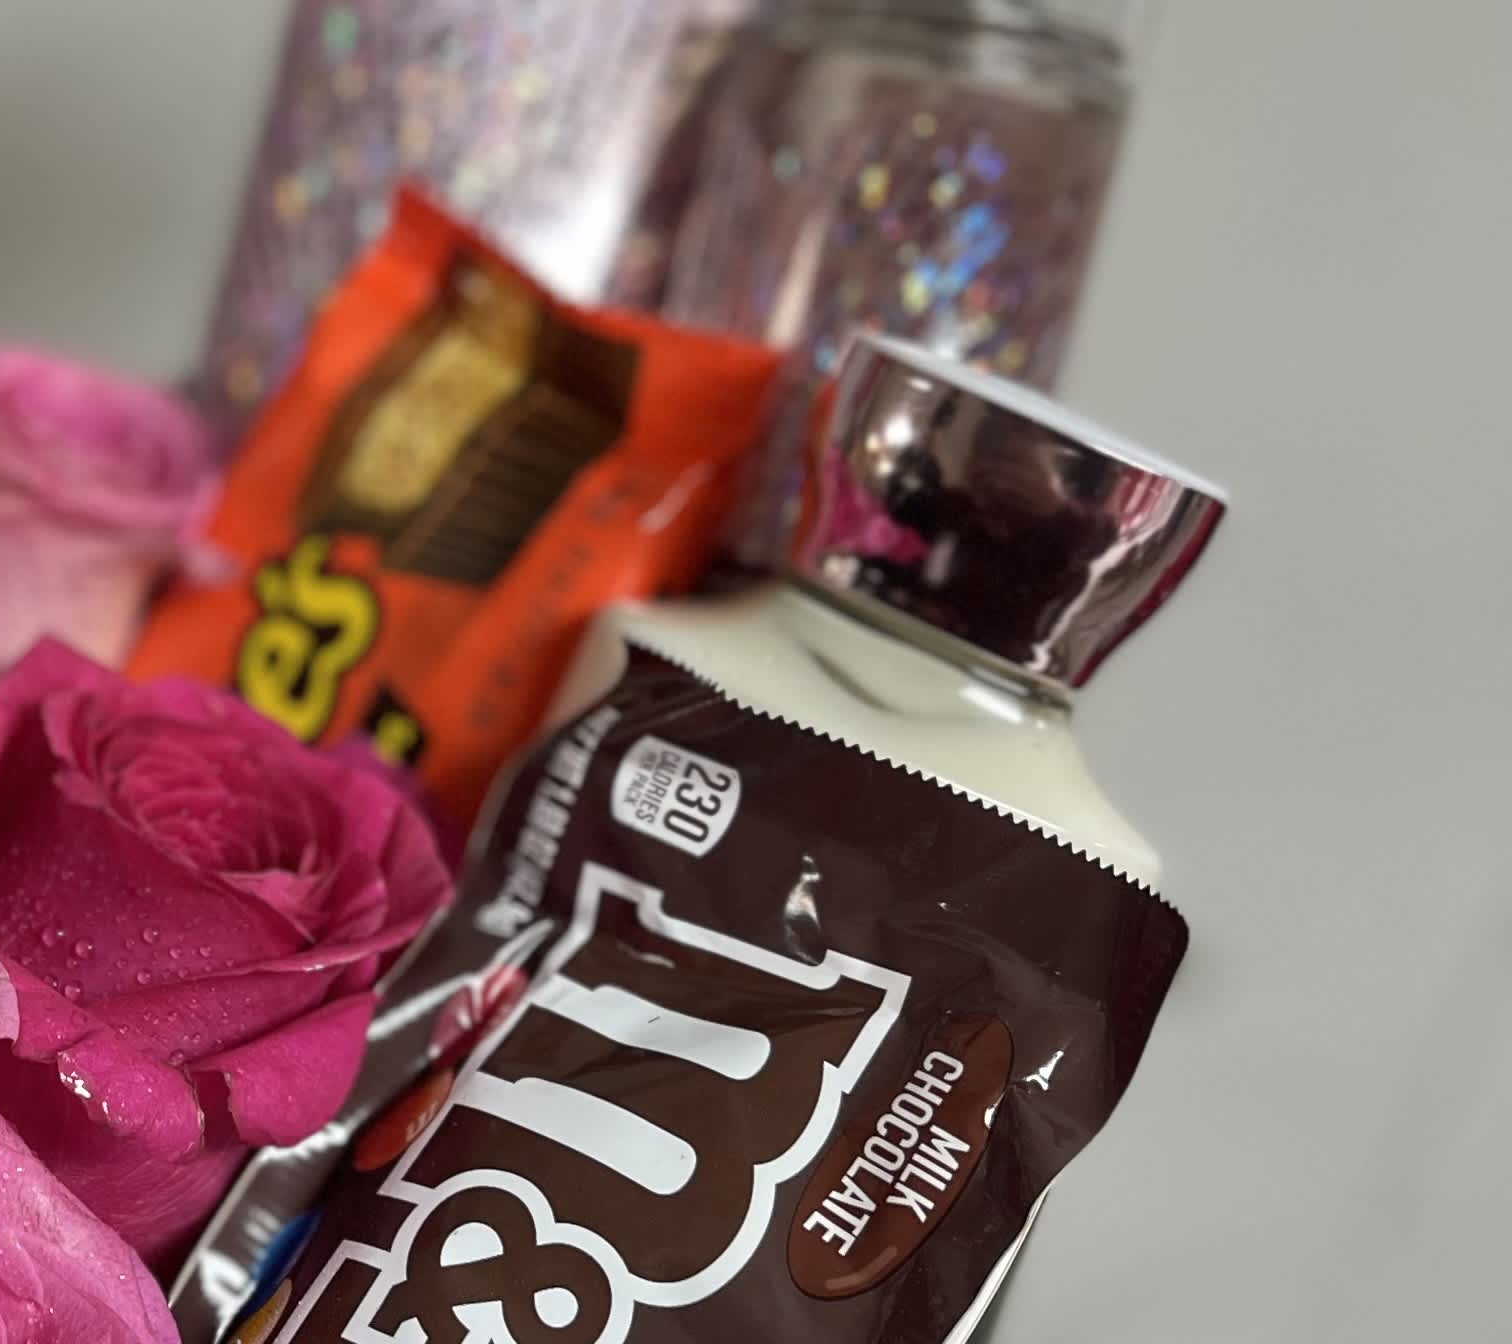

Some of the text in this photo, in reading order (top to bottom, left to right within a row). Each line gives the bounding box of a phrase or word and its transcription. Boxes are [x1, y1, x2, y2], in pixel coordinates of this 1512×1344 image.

[623, 771, 649, 804] PACK
[635, 751, 681, 824] CALORIES
[664, 761, 732, 843] 230
[802, 1050, 964, 1257] CHOCOLATE
[885, 1124, 970, 1223] MILK
